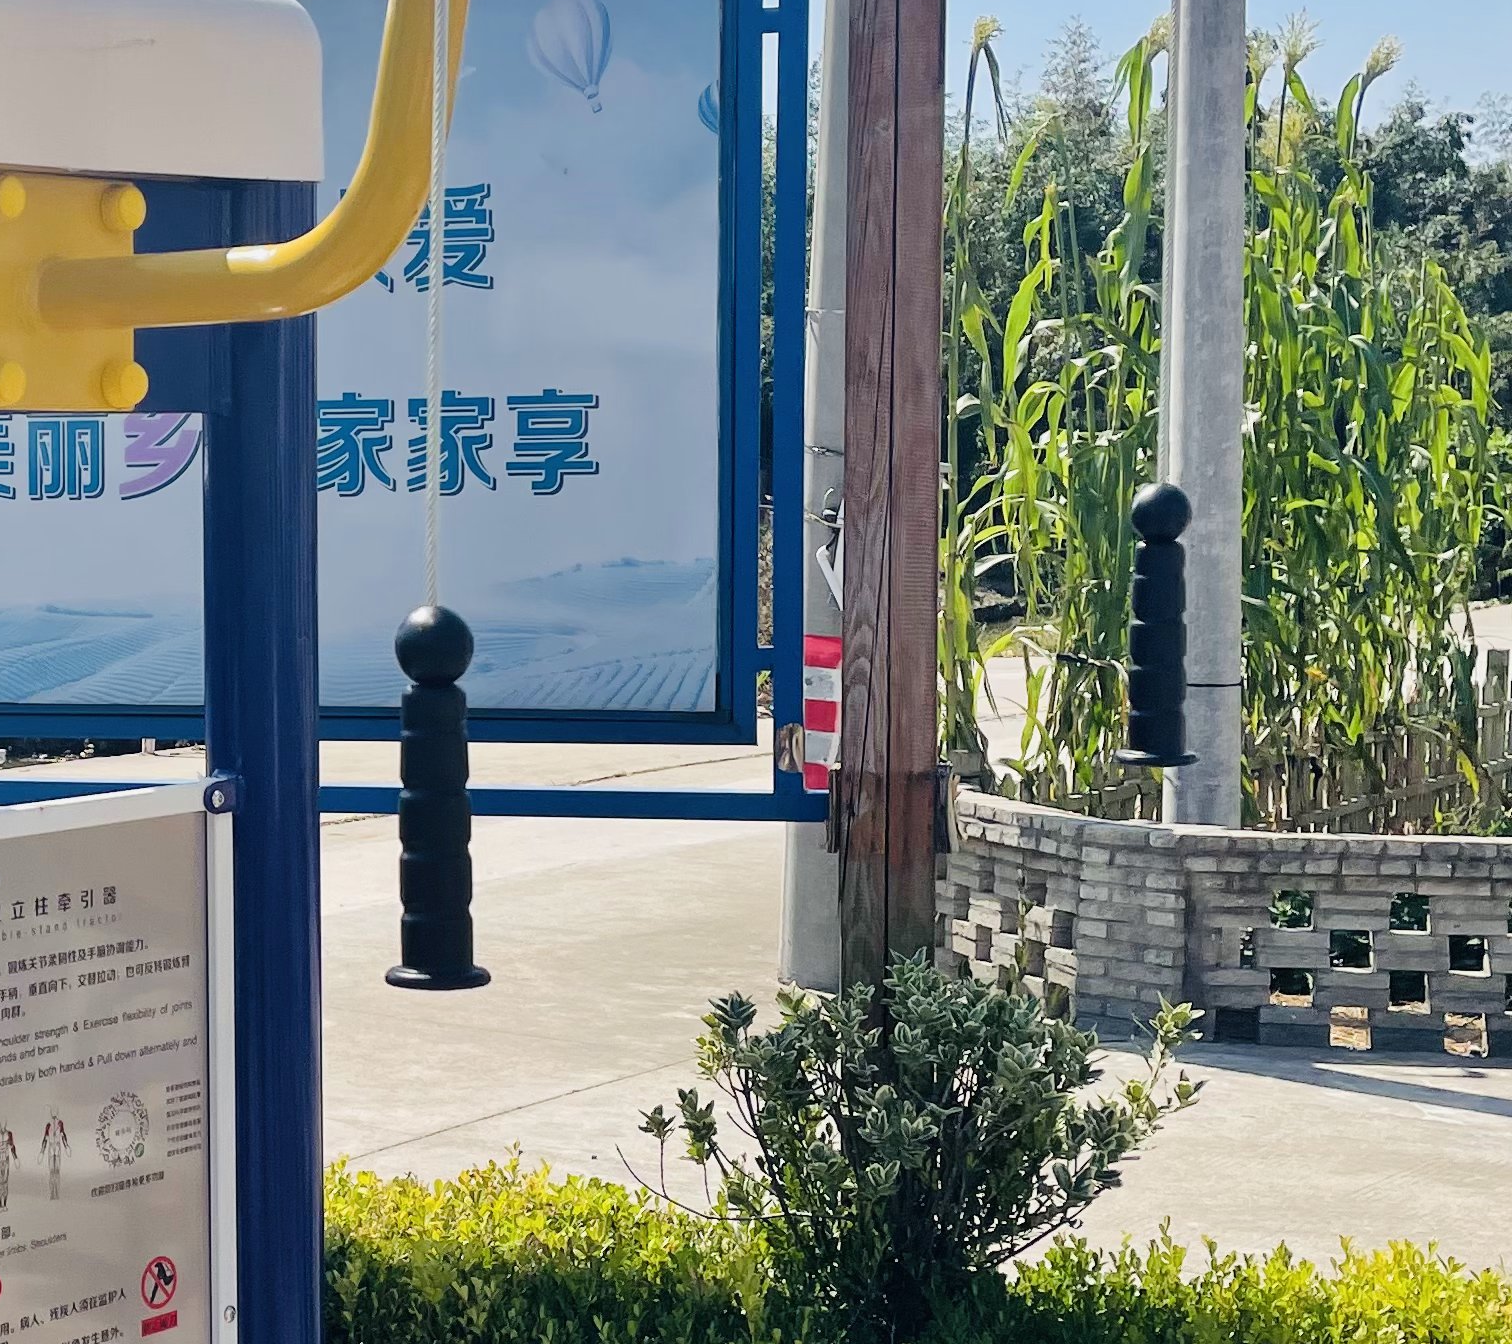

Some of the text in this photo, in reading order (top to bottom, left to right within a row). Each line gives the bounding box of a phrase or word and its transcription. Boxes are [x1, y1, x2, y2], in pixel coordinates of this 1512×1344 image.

[34, 1025, 68, 1040] strength
[83, 1015, 118, 1030] Exercise
[160, 1004, 167, 1014] of
[171, 1000, 192, 1015] joints
[19, 1047, 35, 1059] and
[38, 1043, 58, 1055] brain
[25, 1070, 35, 1082] by
[38, 1065, 56, 1078] both
[59, 1059, 84, 1073] hands
[97, 1052, 112, 1065] Pull
[114, 1048, 136, 1061] down
[183, 1034, 197, 1047] and
